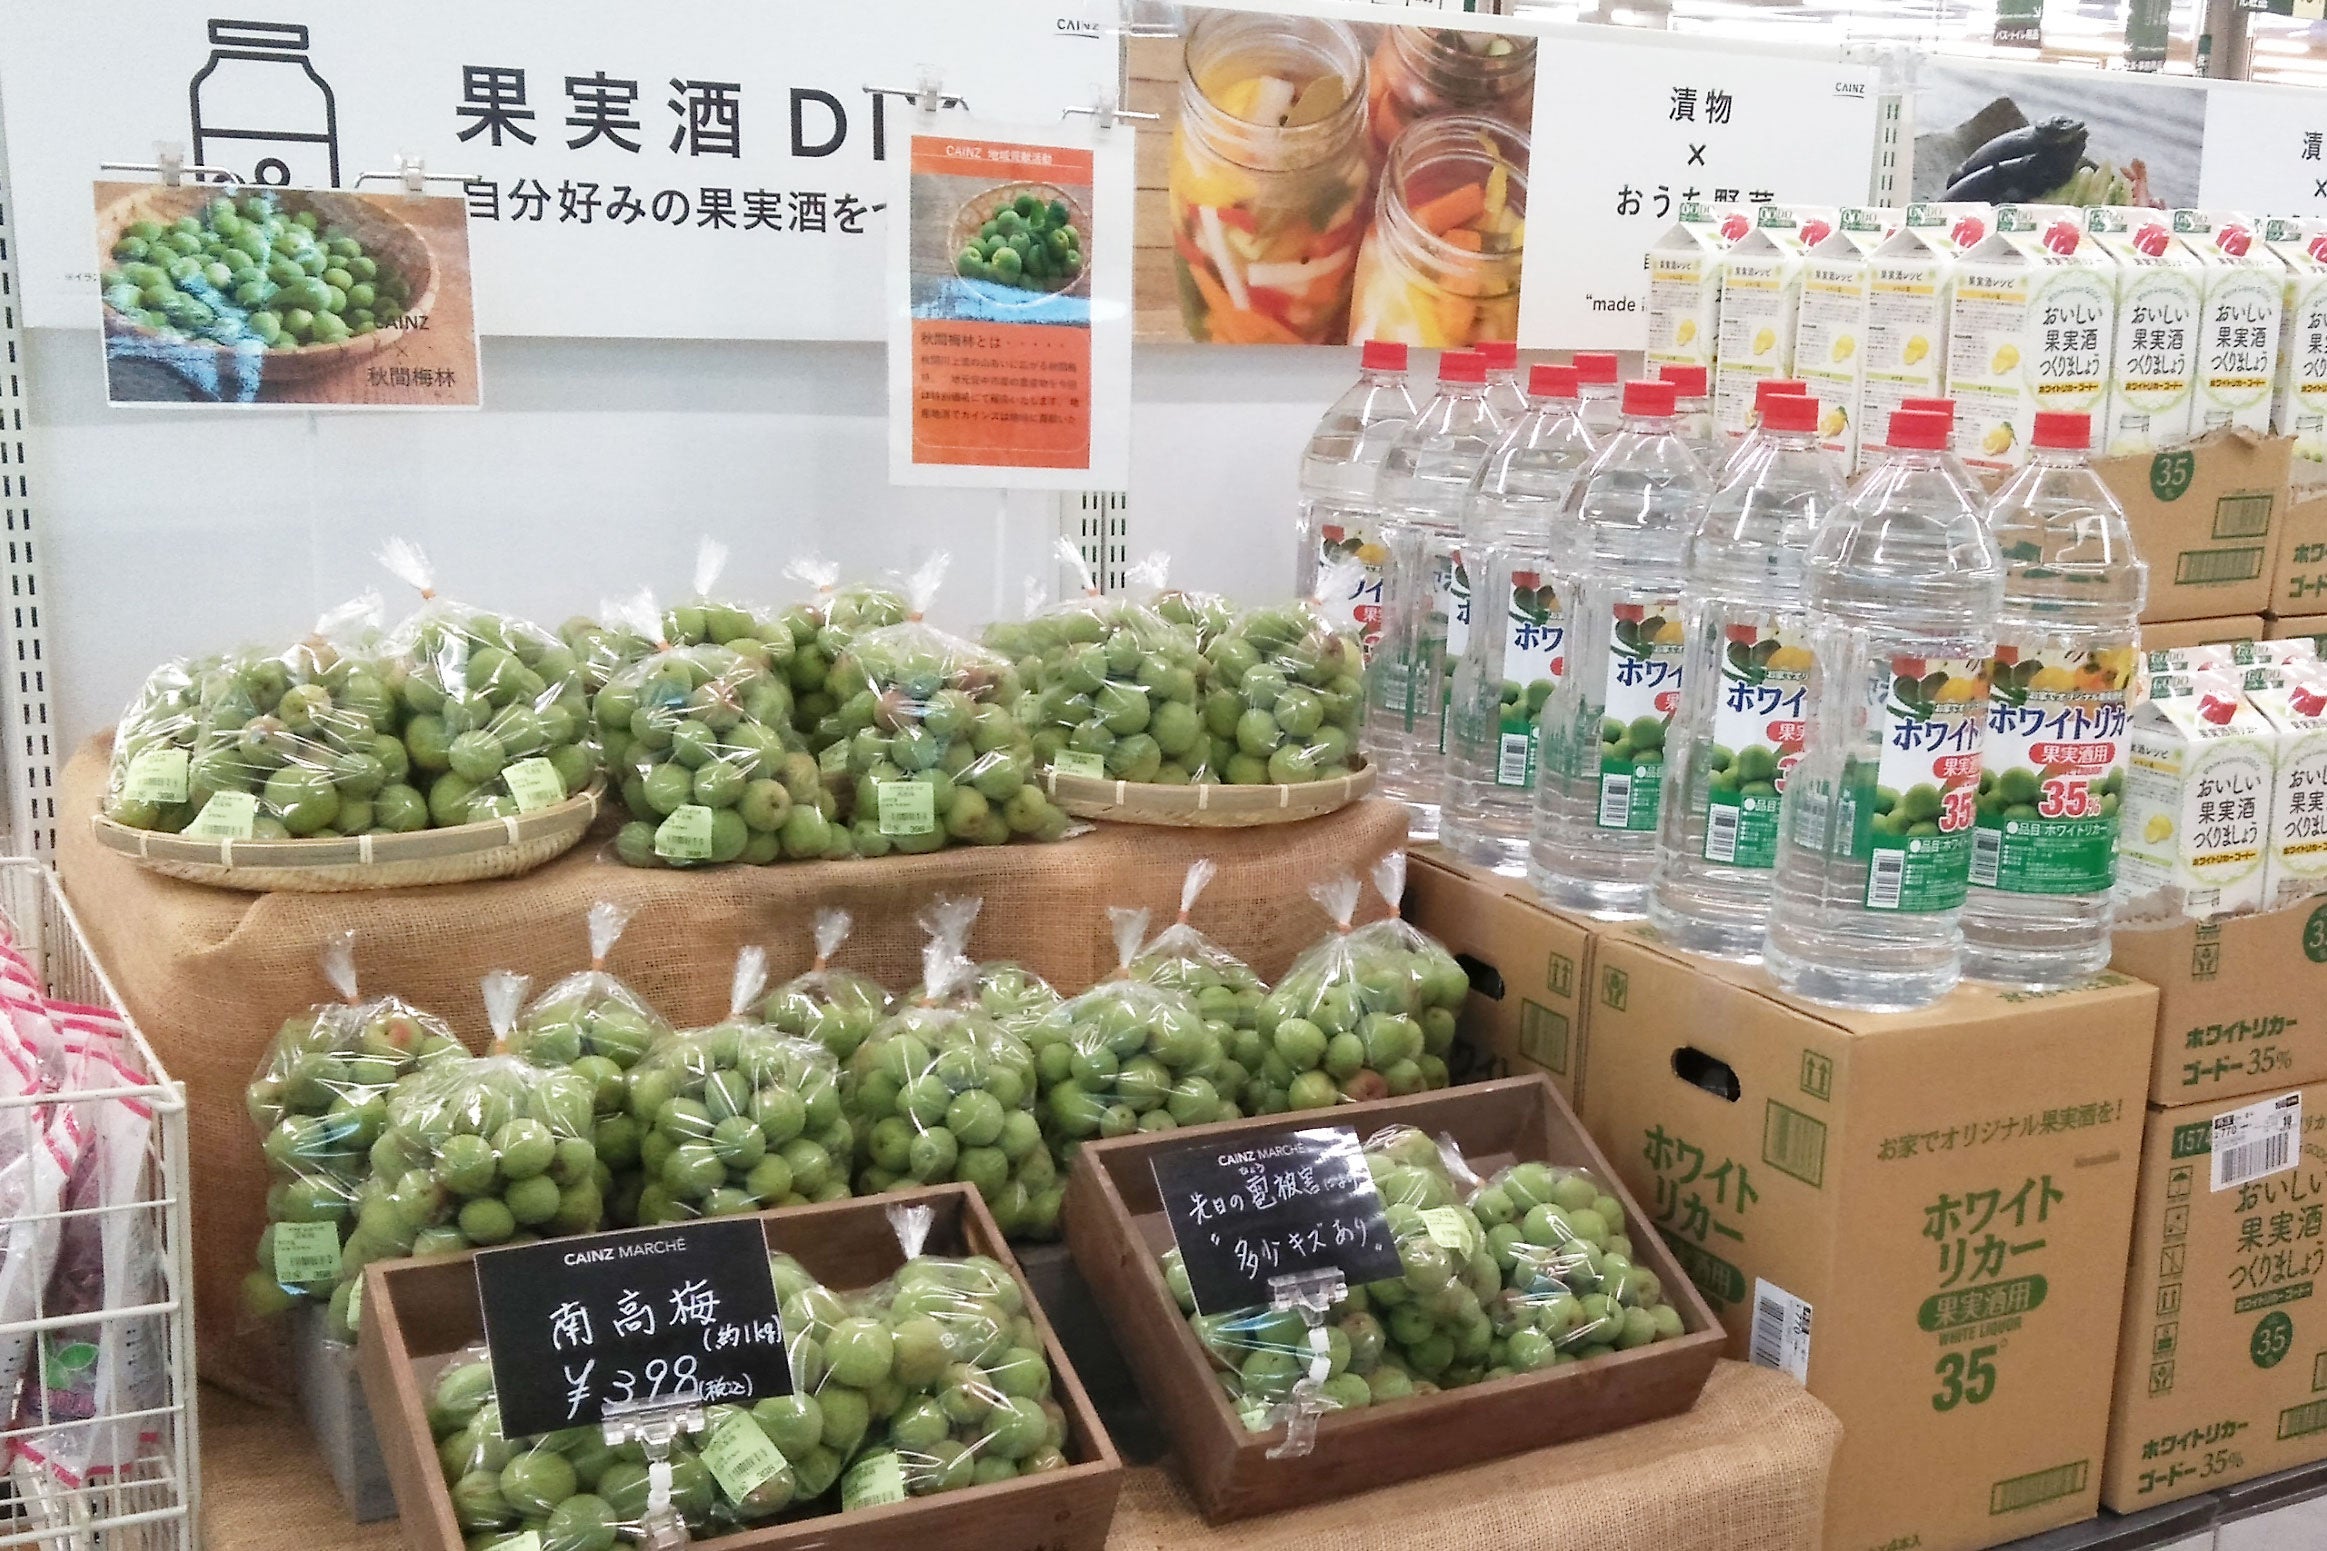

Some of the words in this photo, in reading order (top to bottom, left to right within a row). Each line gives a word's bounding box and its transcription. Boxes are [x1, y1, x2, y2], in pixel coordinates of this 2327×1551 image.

[1057, 17, 1099, 33] CAINZ
[1835, 82, 1866, 94] CAINZ
[457, 65, 741, 159] 果実酒
[1669, 86, 1732, 124] 漬物
[945, 144, 982, 159] CAINZ
[467, 178, 887, 235] 自分好みの果実酒を
[374, 314, 430, 332] CAINZ
[2043, 304, 2102, 325] おいしい
[2131, 304, 2189, 325] おいしい
[2215, 302, 2272, 323] おいしい
[2045, 329, 2098, 351] 果実酒
[2132, 328, 2184, 351] 果実酒
[2216, 326, 2266, 348] 果実酒
[2039, 355, 2099, 377] つくりましょう
[2127, 354, 2186, 376] つくりましょう
[2210, 352, 2268, 373] つくりましょう
[367, 365, 457, 389] 秋間梅林
[2157, 458, 2189, 486] 35
[1989, 702, 2134, 740] ホワイトリカー
[2041, 744, 2108, 764] 果実酒用
[2197, 773, 2262, 799] おいしい
[2199, 797, 2256, 824] 果実酒
[2193, 821, 2258, 849] つくりましょう
[2186, 1015, 2298, 1049] ホワイトリカー
[2246, 1045, 2293, 1075] 35%
[1218, 1150, 1257, 1167] CAINZ
[1643, 1123, 1760, 1214] ホワイト
[1655, 1175, 1746, 1243] リカー
[1922, 1174, 2064, 1241] ホワイト
[2237, 1203, 2325, 1253] 果実酒
[564, 1248, 615, 1266] CAINZ
[1939, 1233, 2046, 1288] リカー
[2228, 1240, 2325, 1290] つくりましょう
[549, 1279, 721, 1350] 南高梅
[1935, 1280, 2031, 1328] 果実酒用
[2257, 1324, 2287, 1356] 35
[1931, 1344, 1998, 1413] 35
[2141, 1420, 2249, 1460] ホワイトリカー
